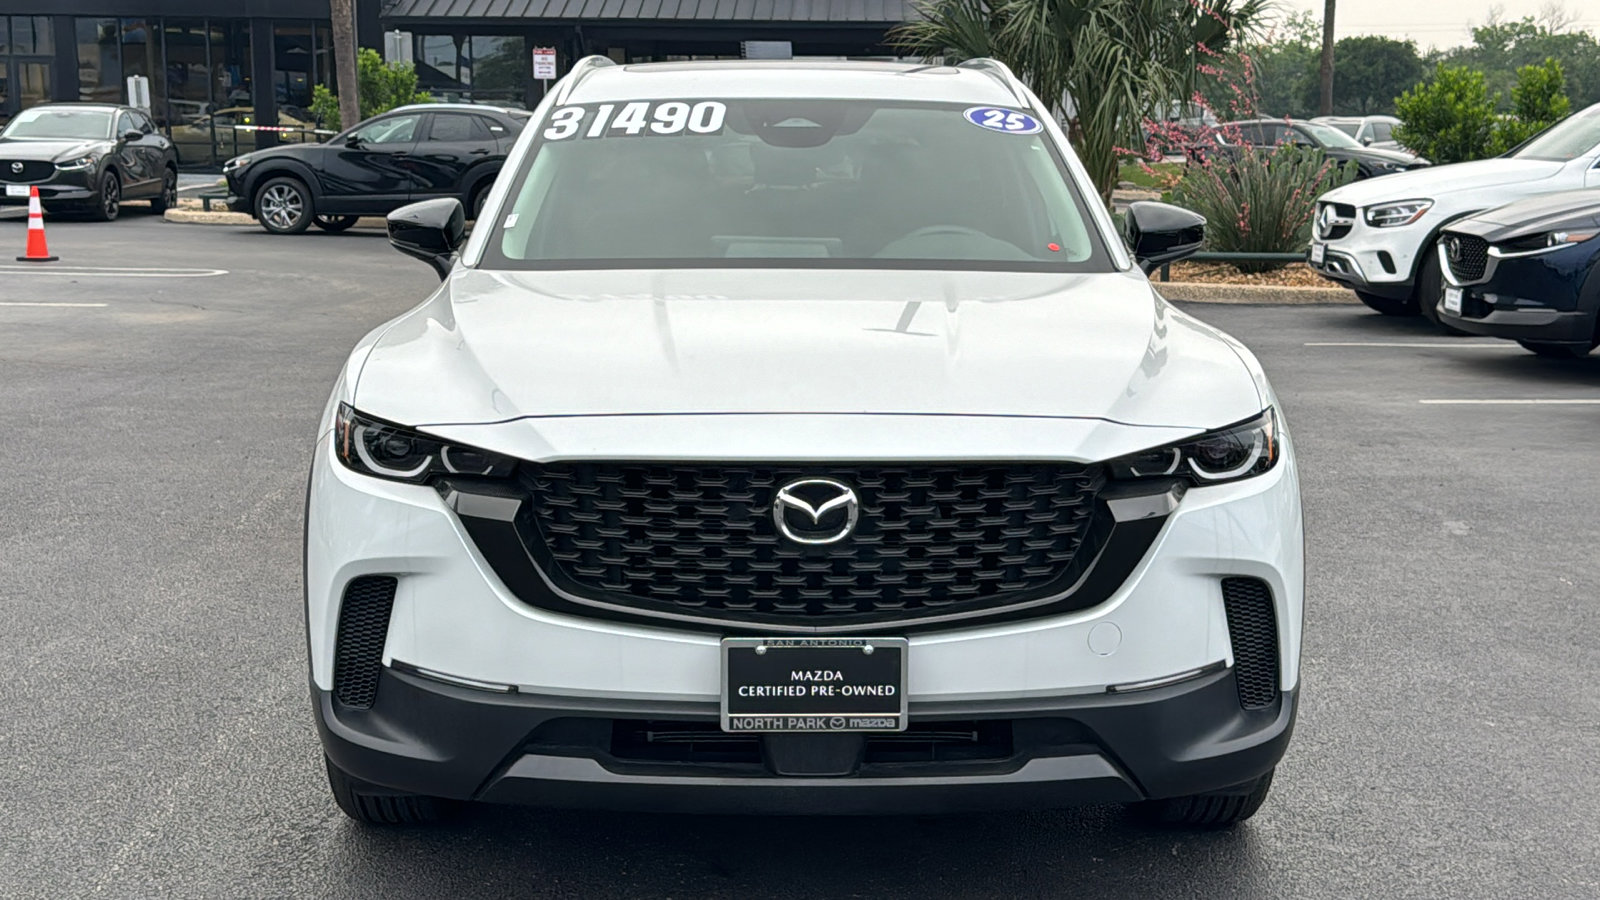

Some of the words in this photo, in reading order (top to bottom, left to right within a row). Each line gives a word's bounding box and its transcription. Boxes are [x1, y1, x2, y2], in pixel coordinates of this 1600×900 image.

[543, 101, 727, 140] 31490
[982, 110, 1025, 131] 25
[790, 670, 844, 681] MAZDA
[738, 685, 806, 697] CERTIFIED
[810, 685, 896, 697] PRE-OWNED
[733, 718, 784, 729] NORTH
[788, 718, 827, 729] PARK
[850, 718, 896, 728] mazda
